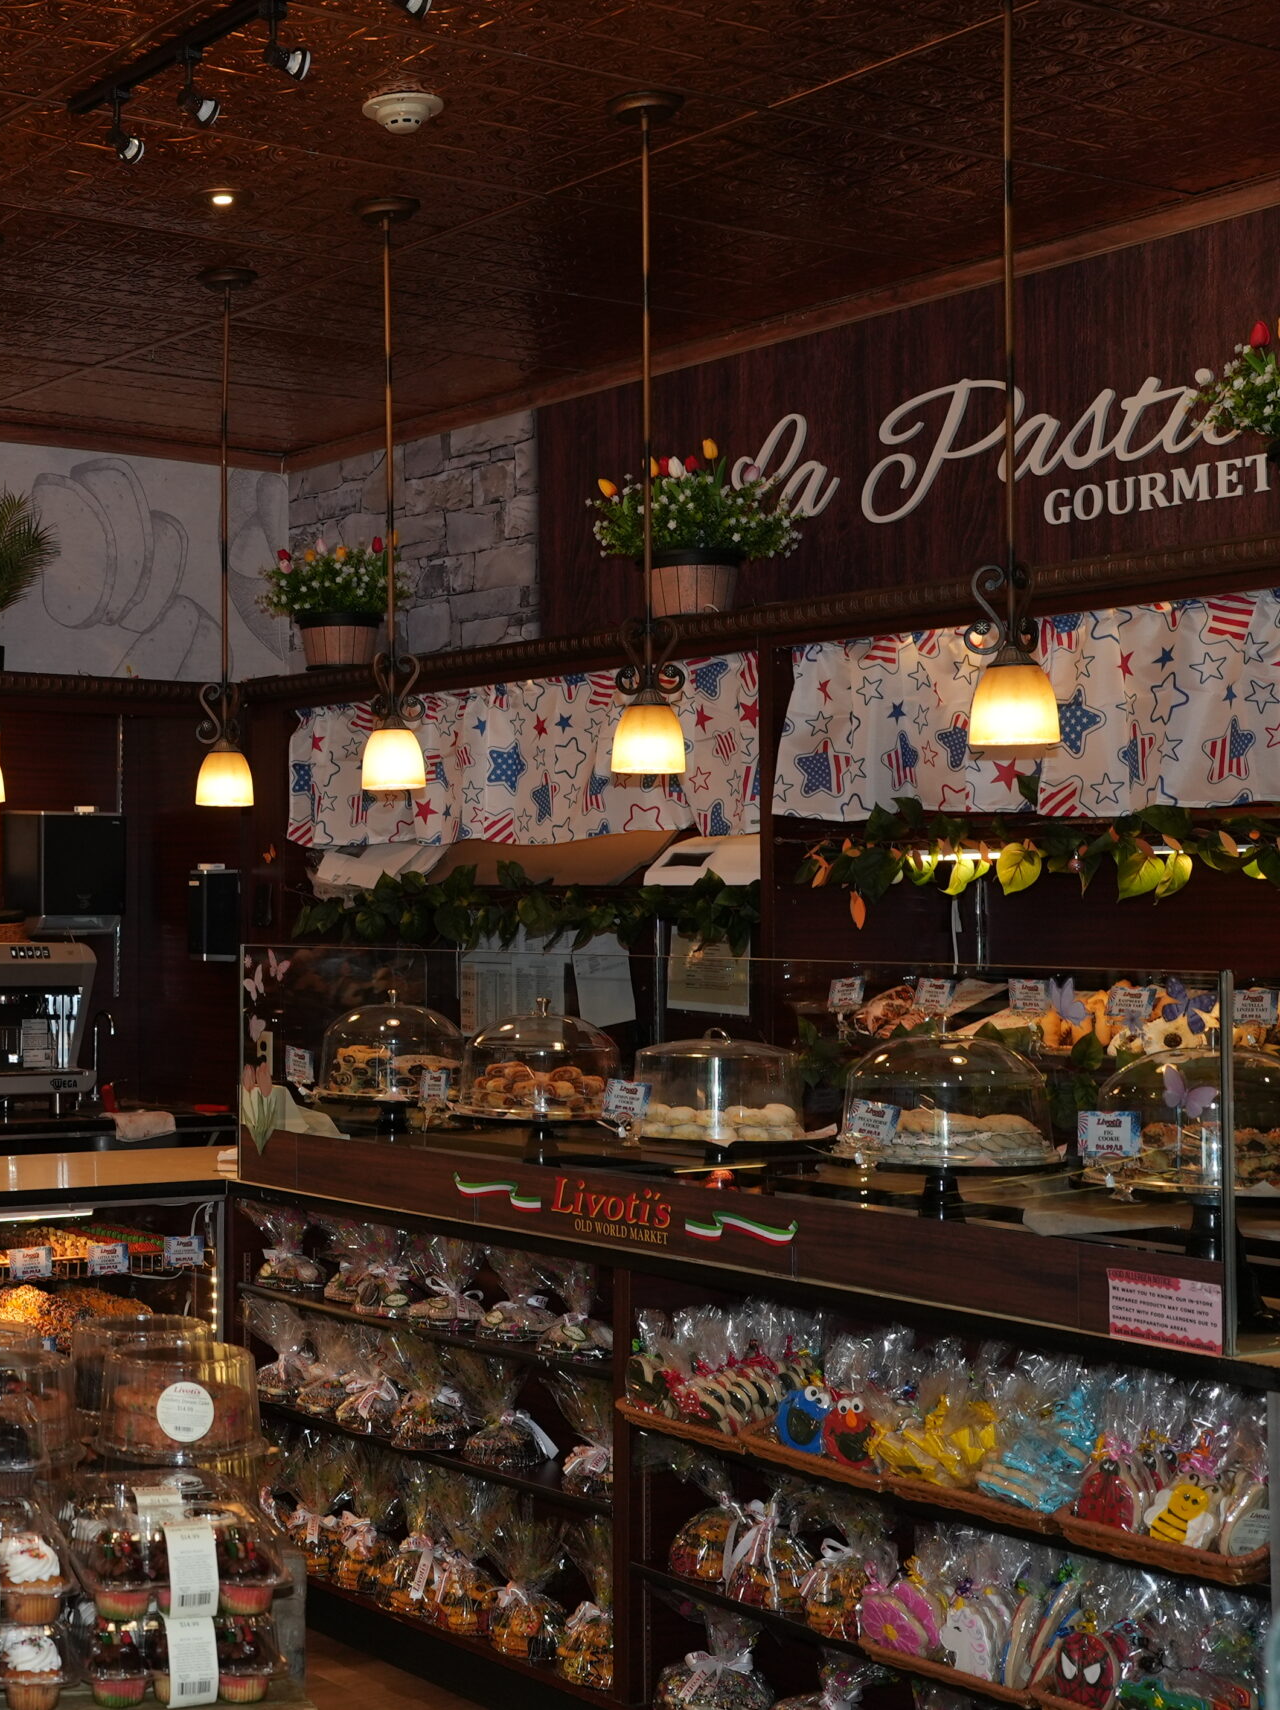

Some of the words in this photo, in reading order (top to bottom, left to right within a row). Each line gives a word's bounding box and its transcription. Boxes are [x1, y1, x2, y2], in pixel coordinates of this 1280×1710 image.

[1043, 453, 1271, 525] GOURMET
[551, 1176, 671, 1228] Livoti's
[575, 1218, 592, 1232] OLD
[594, 1221, 628, 1238] WORLD
[630, 1227, 668, 1245] MARKET
[1112, 1296, 1138, 1304] PREPARED
[1140, 1299, 1166, 1309] PRODUCTS
[1188, 1298, 1213, 1307] IN-STORE
[1112, 1305, 1136, 1313] CONTACT
[1166, 1314, 1196, 1324] ALLERGENS
[1134, 1318, 1168, 1329] PREPARATION
